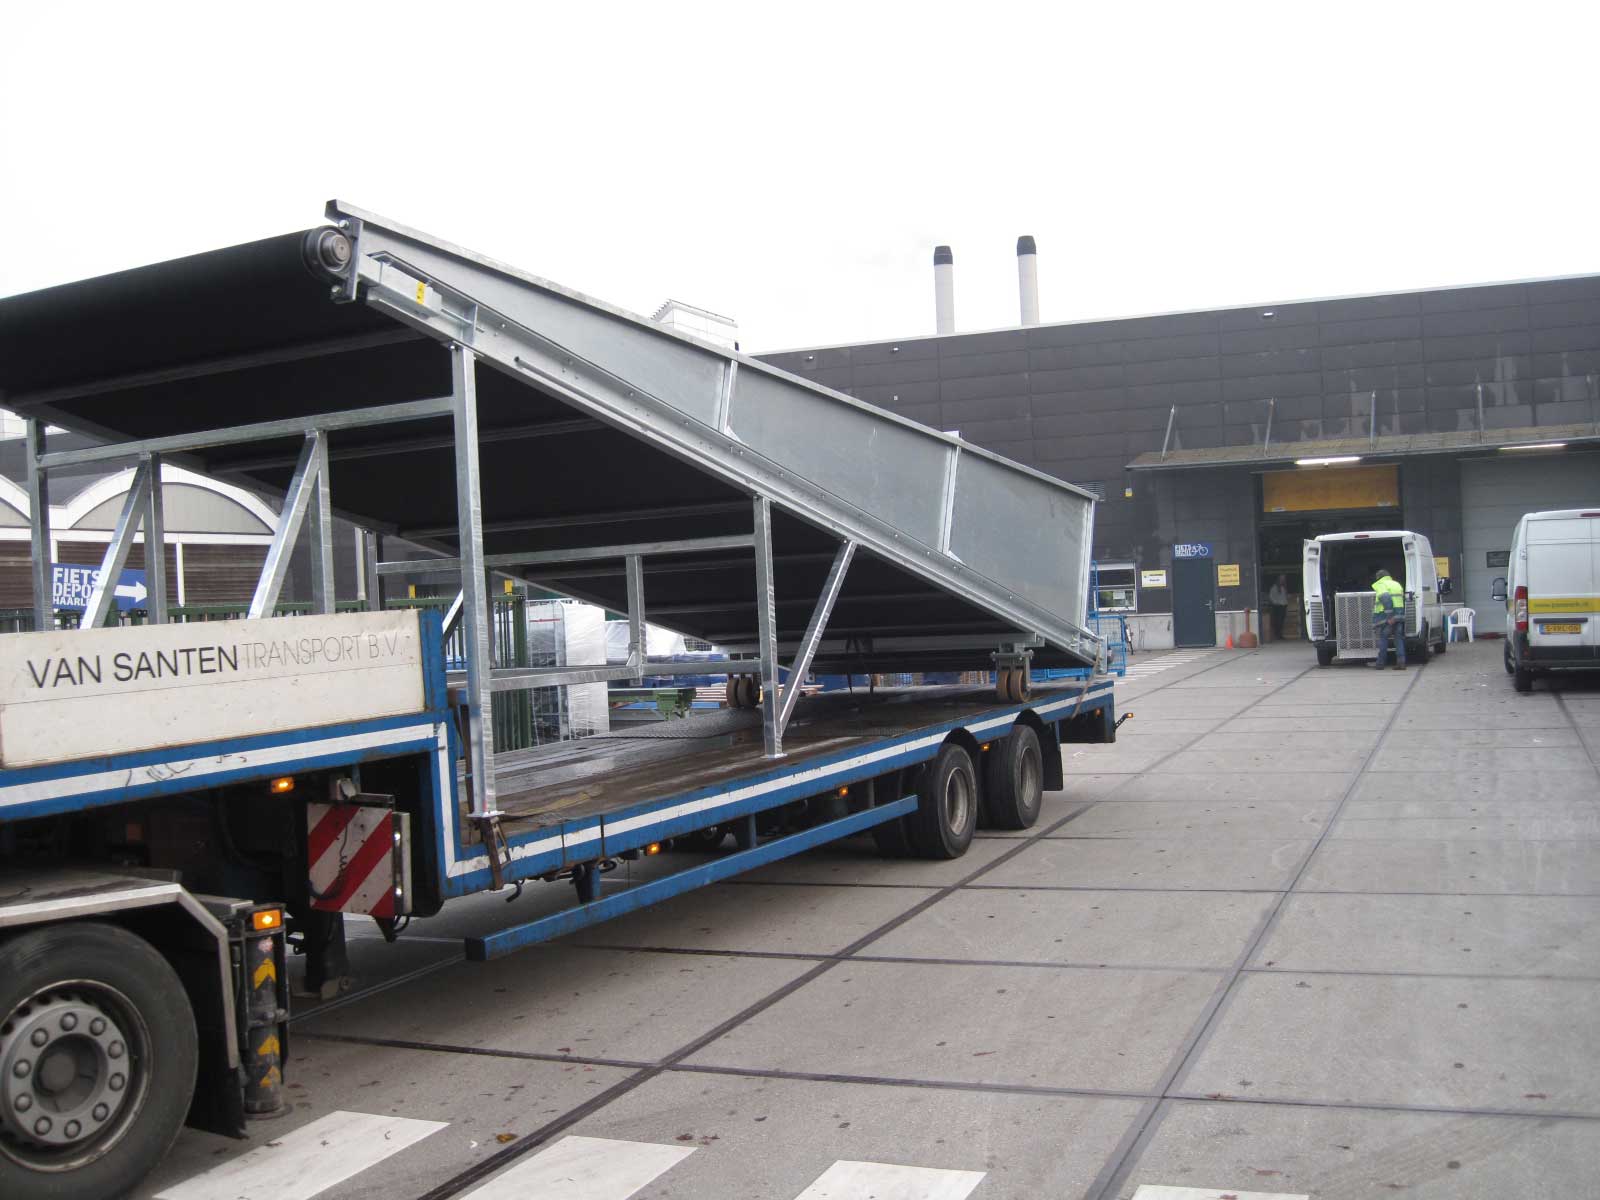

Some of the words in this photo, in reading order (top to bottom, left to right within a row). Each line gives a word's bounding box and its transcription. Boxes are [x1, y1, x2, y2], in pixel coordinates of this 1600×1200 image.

[52, 582, 95, 599] DEPO
[27, 654, 102, 689] VAN
[113, 643, 238, 682] SANTEN
[242, 634, 362, 669] TRANSPORT
